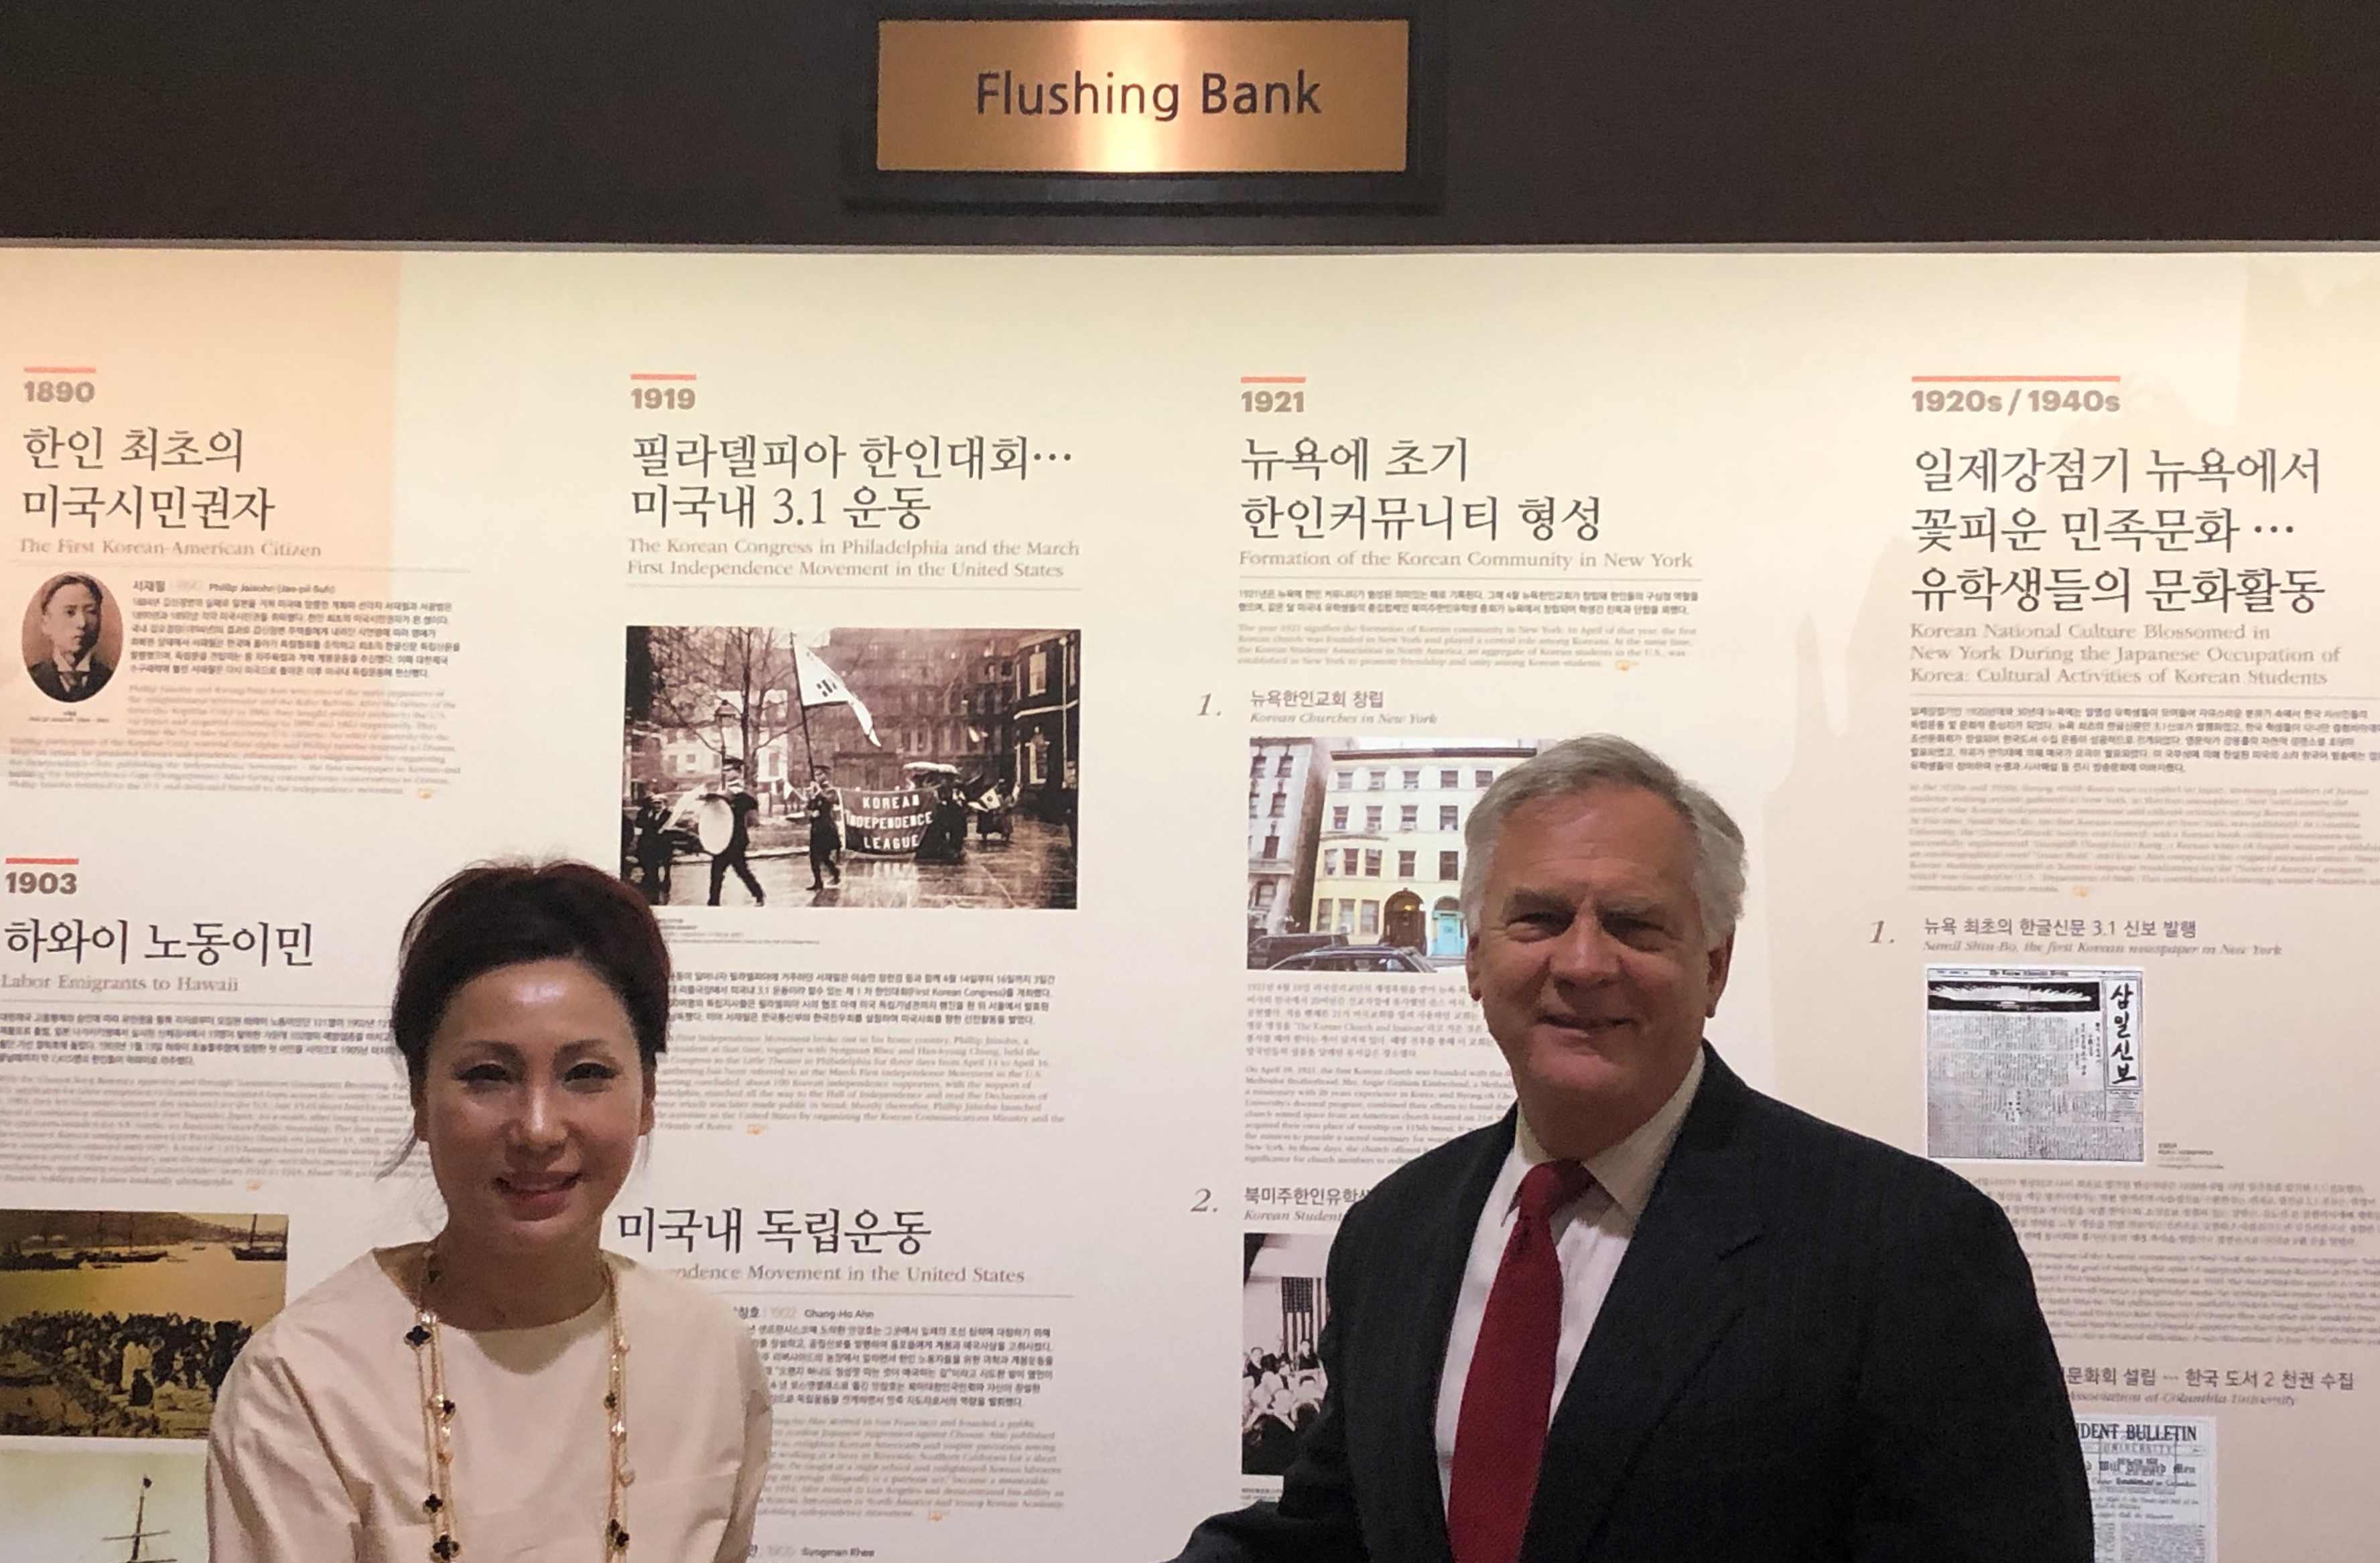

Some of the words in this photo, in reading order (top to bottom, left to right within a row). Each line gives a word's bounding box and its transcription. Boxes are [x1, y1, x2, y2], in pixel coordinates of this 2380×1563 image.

[978, 70, 1179, 123] Flushing
[1202, 69, 1320, 115] Bank
[23, 380, 95, 403] 1890
[631, 387, 696, 410] 1919
[1241, 390, 1305, 413] 1921
[1912, 389, 2003, 413] 1920s
[2028, 389, 2121, 413] 1940s
[23, 425, 103, 470] 한인
[121, 426, 243, 472] 최초의
[633, 433, 847, 480] 필라델피아
[1241, 436, 1368, 482] 뉴욕에
[1385, 436, 1467, 482] 초기
[1916, 447, 2128, 494] 일제강점기
[2145, 447, 2319, 494] 뉴욕에서
[23, 484, 275, 531] 미국시민권자
[631, 483, 755, 529] 미국내
[773, 488, 825, 526] 3.1
[843, 485, 931, 530] 운동
[1241, 495, 1497, 541] 한인커뮤니티
[1518, 496, 1599, 541] 형성
[1911, 506, 2047, 553] 꽃피운
[2061, 506, 2241, 553] 민족문화
[20, 537, 51, 553] The
[57, 538, 94, 553] First
[103, 539, 255, 555] Korean-American
[260, 541, 322, 557] Citizen
[629, 537, 661, 553] The
[667, 539, 728, 553] Korean
[734, 539, 813, 557] Congress
[819, 539, 836, 555] in
[842, 538, 949, 559] Philadelphia
[955, 539, 987, 555] and
[992, 540, 1020, 555] the
[1027, 540, 1081, 557] March
[628, 560, 664, 574] First
[671, 559, 793, 580] Independence
[800, 561, 888, 576] Movement
[896, 561, 911, 576] in
[917, 561, 945, 577] the
[951, 561, 1008, 577] United
[1014, 563, 1064, 577] States
[1239, 550, 1331, 565] Formation
[1337, 550, 1357, 565] of
[1361, 550, 1391, 566] the
[1397, 551, 1461, 566] Korean
[1467, 551, 1573, 571] Community
[1579, 552, 1597, 567] in
[1604, 552, 1644, 567] New
[1650, 551, 1693, 568] York
[133, 580, 166, 594] 서재필
[1912, 566, 2129, 613] 유학생들의
[2145, 567, 2326, 614] 문화활동
[1910, 622, 1977, 638] Korean
[1984, 622, 2061, 638] National
[2068, 622, 2136, 639] Culture
[2143, 623, 2246, 640] Blossomed
[2253, 626, 2271, 640] in
[1911, 645, 1951, 660] New
[1959, 644, 2001, 661] York
[2009, 645, 2074, 665] During
[2080, 644, 2111, 661] the
[2113, 646, 2200, 665] Japanese
[2206, 647, 2315, 665] Occupation
[2321, 647, 2341, 663] of
[1976, 667, 2050, 683] Cultural
[2057, 668, 2141, 683] Activities
[2148, 667, 2168, 683] of
[2174, 668, 2241, 684] Korean
[2248, 669, 2328, 685] Students
[1250, 689, 1346, 708] 뉴욕한인교회
[1353, 690, 1384, 709] 창립
[1250, 712, 1297, 723] Korean
[1299, 712, 1358, 724] Churches
[1361, 715, 1374, 724] in
[1378, 713, 1406, 724] New
[1410, 713, 1437, 724] York
[862, 794, 920, 809] KOREAN
[845, 809, 933, 829] INDEPENDENCE
[863, 834, 920, 850] LEAGUE
[5, 872, 77, 895] 1903
[1924, 917, 1957, 935] 뉴욕
[1964, 918, 2013, 936] 최초의
[2020, 918, 2086, 937] 한글신문
[2093, 920, 2115, 937] 3.1
[2123, 920, 2157, 938] 신보
[2163, 921, 2196, 939] 발행
[4, 918, 128, 965] 하와이
[144, 921, 313, 967] 노동이민
[1, 973, 52, 989] Labor
[58, 974, 147, 993] Emigrants
[152, 978, 171, 991] to
[177, 976, 239, 992] Hawaii
[2110, 982, 2137, 1085] 삼일신보
[1190, 1188, 1217, 1213] 2.
[1244, 1209, 1290, 1221] Korean
[1294, 1210, 1343, 1221] Student
[617, 1207, 742, 1254] 미국내
[756, 1208, 932, 1255] 독립운동
[672, 1263, 740, 1280] ndence
[748, 1264, 841, 1280] Movement
[848, 1266, 864, 1282] in
[871, 1265, 900, 1282] the
[907, 1266, 966, 1282] United
[973, 1268, 1025, 1283] States
[734, 1306, 760, 1320] 창호
[2061, 1366, 2117, 1385] 문화회
[2123, 1367, 2156, 1387] 설립
[2185, 1368, 2219, 1388] 한국
[2225, 1369, 2258, 1388] 도서
[2264, 1371, 2274, 1388] 2
[2282, 1369, 2314, 1389] 천권
[2320, 1372, 2354, 1391] 수집
[2077, 1422, 2119, 1440] DENT
[2125, 1424, 2197, 1442] BULLETIN
